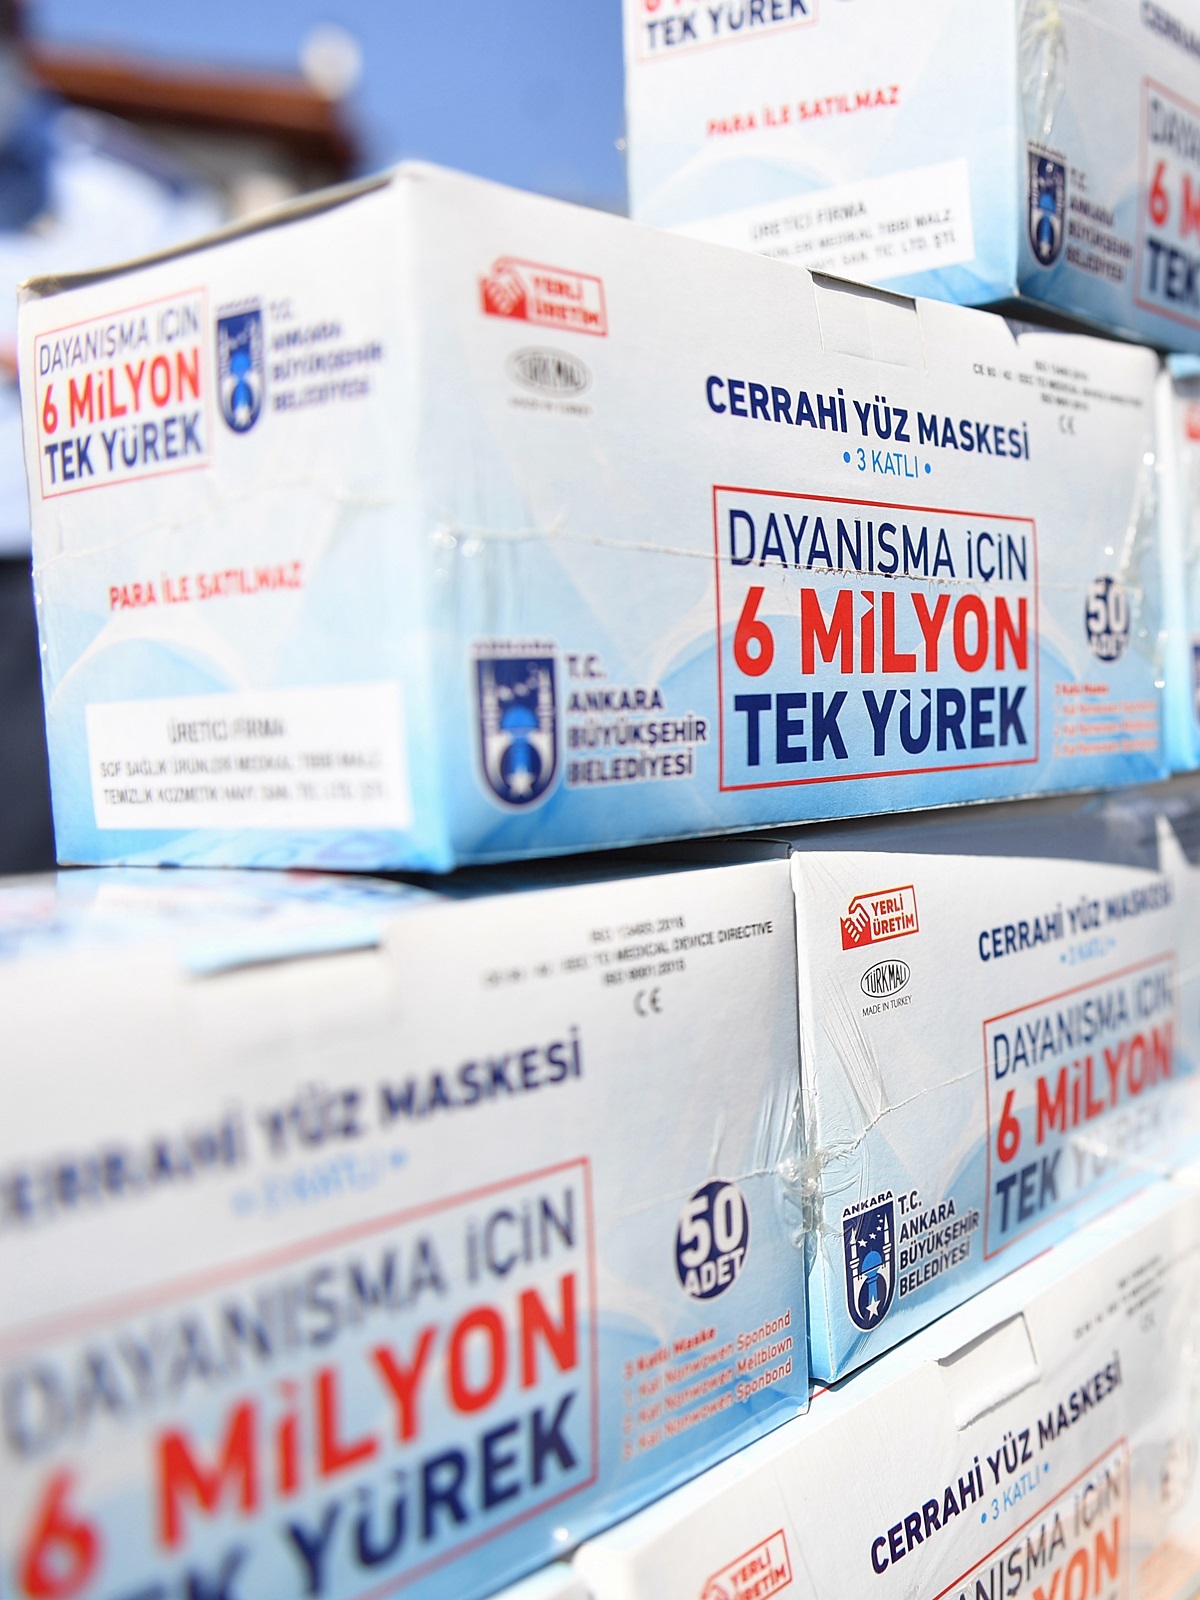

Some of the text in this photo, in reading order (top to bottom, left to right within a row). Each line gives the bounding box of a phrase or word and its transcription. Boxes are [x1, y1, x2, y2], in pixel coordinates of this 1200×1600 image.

[646, 11, 697, 48] TEK
[707, 112, 756, 136] PARA
[800, 84, 900, 121] SATILMAZ
[1148, 159, 1170, 228] 6
[1147, 236, 1200, 312] TEK
[42, 347, 200, 434] 6 MİLYON
[706, 375, 1030, 461] CERRAHİ YÜZ MASKESİ
[44, 411, 202, 484] TEK YÜREK
[856, 448, 919, 478] 3 KATLI
[966, 530, 1028, 582] İÇİN
[109, 561, 303, 612] PARA İLE SATILMAZ
[1088, 582, 1127, 634] 50
[733, 586, 1028, 677] 6 MİLYON
[569, 689, 663, 712] ANKARA
[734, 691, 849, 767] TEK
[862, 686, 1028, 757] YÜREK
[568, 715, 707, 748] BÜYÜKŞEHİR
[569, 749, 693, 783] BELEDİYESİ
[871, 893, 904, 916] YERLİ
[873, 913, 914, 936] ÜRETİM
[979, 904, 1064, 962] CERRAHİ
[1066, 896, 1100, 936] YÜZ
[674, 931, 714, 953] DEVICE
[718, 920, 774, 943] DIRECTIVE
[863, 995, 913, 1016] MADE IN TURKEY
[378, 1024, 583, 1128] MASKESİ
[996, 1018, 1174, 1164] 6 MİLYON
[843, 1191, 893, 1218] ANKARA
[898, 1191, 922, 1215] T.C.
[996, 1149, 1062, 1234] TEK
[679, 1185, 744, 1267] 50
[900, 1199, 955, 1244] ANKARA
[900, 1210, 980, 1270] BÜYÜKŞEHİR
[684, 1247, 744, 1296] ADET
[900, 1237, 970, 1297] BELEDİYESİ
[737, 1309, 791, 1353] Sponbond
[737, 1336, 793, 1377] Meltblown
[736, 1358, 792, 1404] Sponbond
[17, 1271, 579, 1600] 6 MİLYON
[871, 1349, 1122, 1576] CERRAHİ YÜZ MASKESİ
[285, 1389, 580, 1600] YÜREK
[991, 1464, 1041, 1521] 3 KATLI
[731, 1547, 771, 1586] YERLİ
